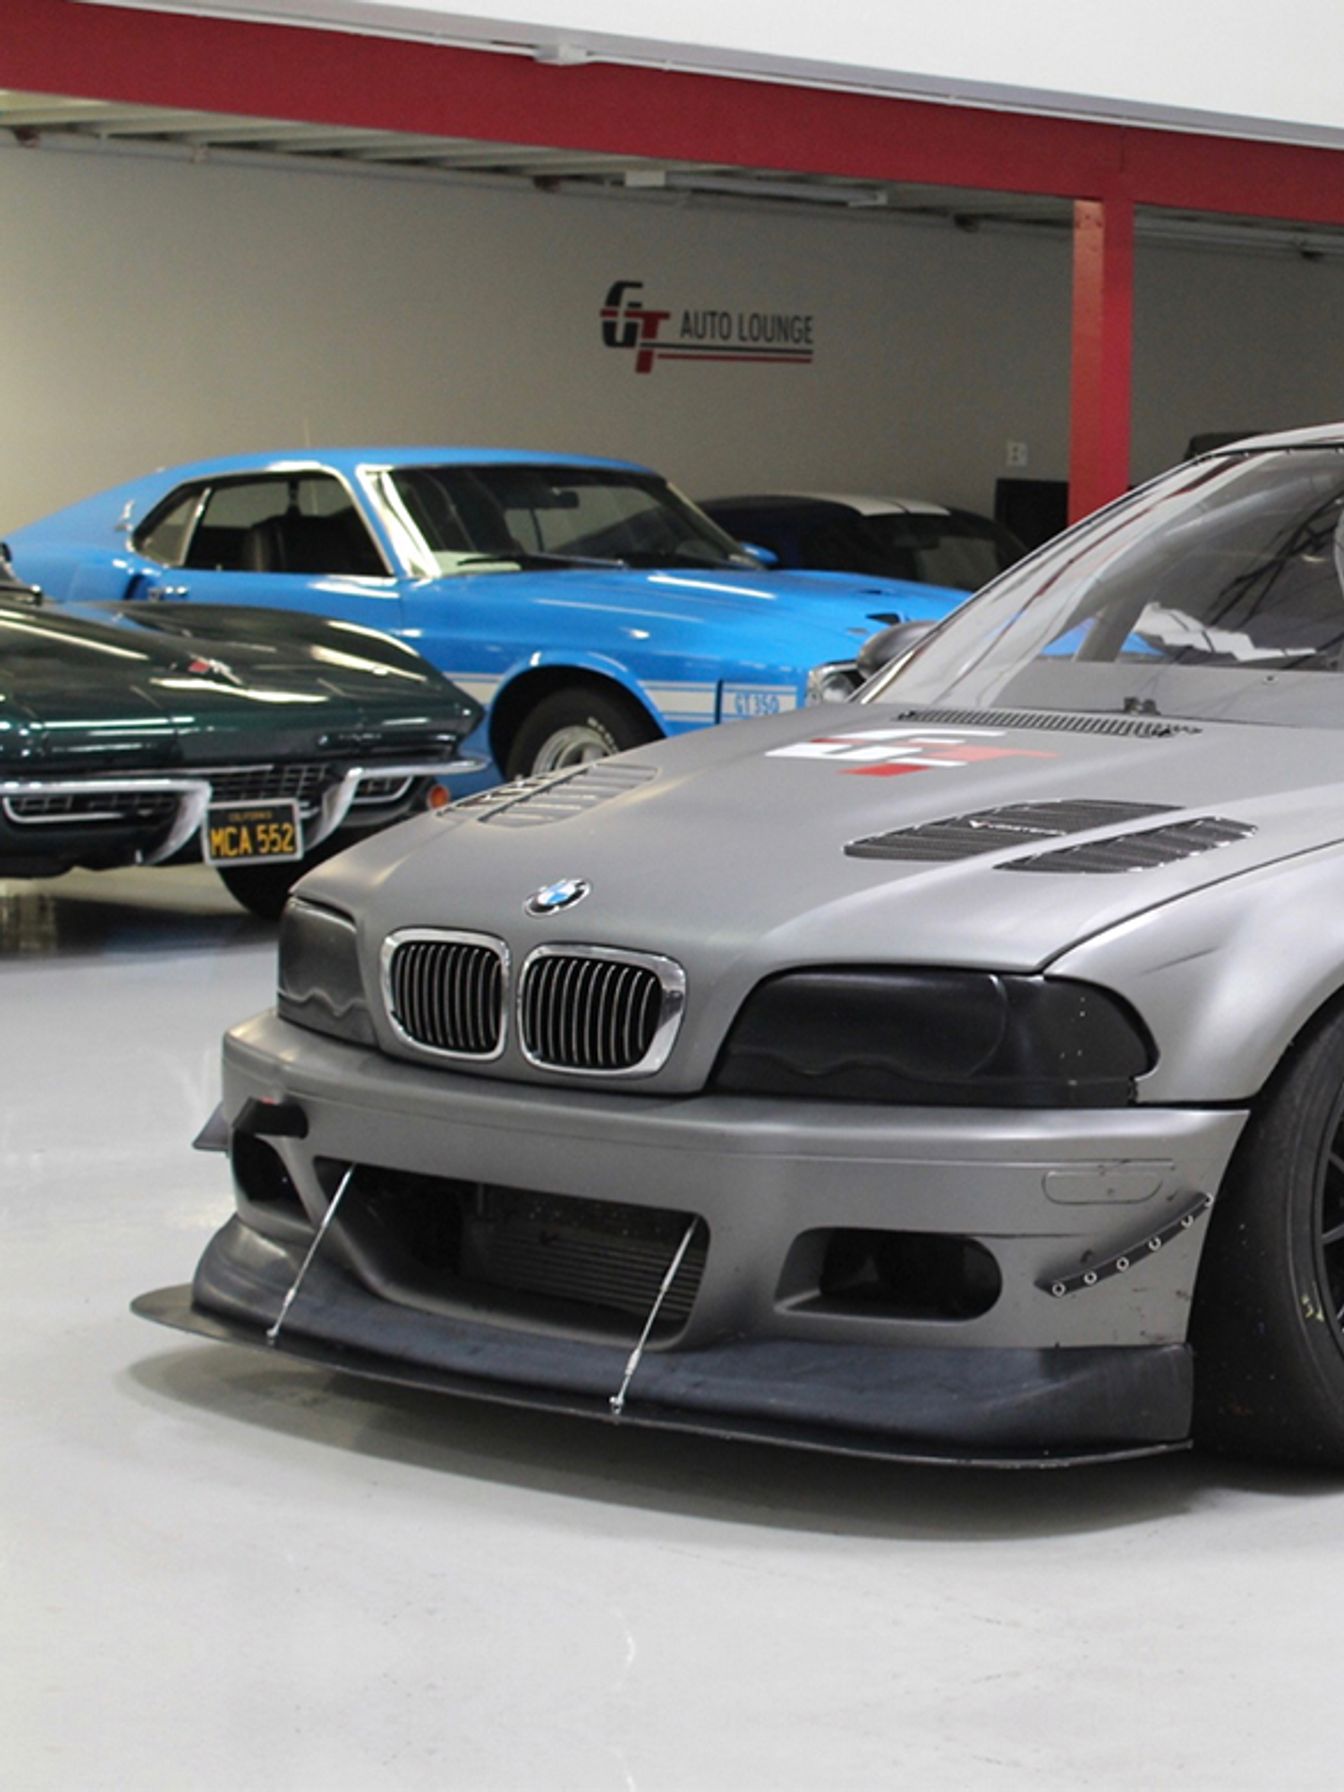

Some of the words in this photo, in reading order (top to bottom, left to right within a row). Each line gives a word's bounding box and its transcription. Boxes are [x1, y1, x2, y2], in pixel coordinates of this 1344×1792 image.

[600, 280, 670, 374] GT
[680, 310, 732, 340] AUTO
[737, 313, 814, 345] LOUNGE
[210, 825, 252, 858] MCA
[256, 822, 295, 854] 552
